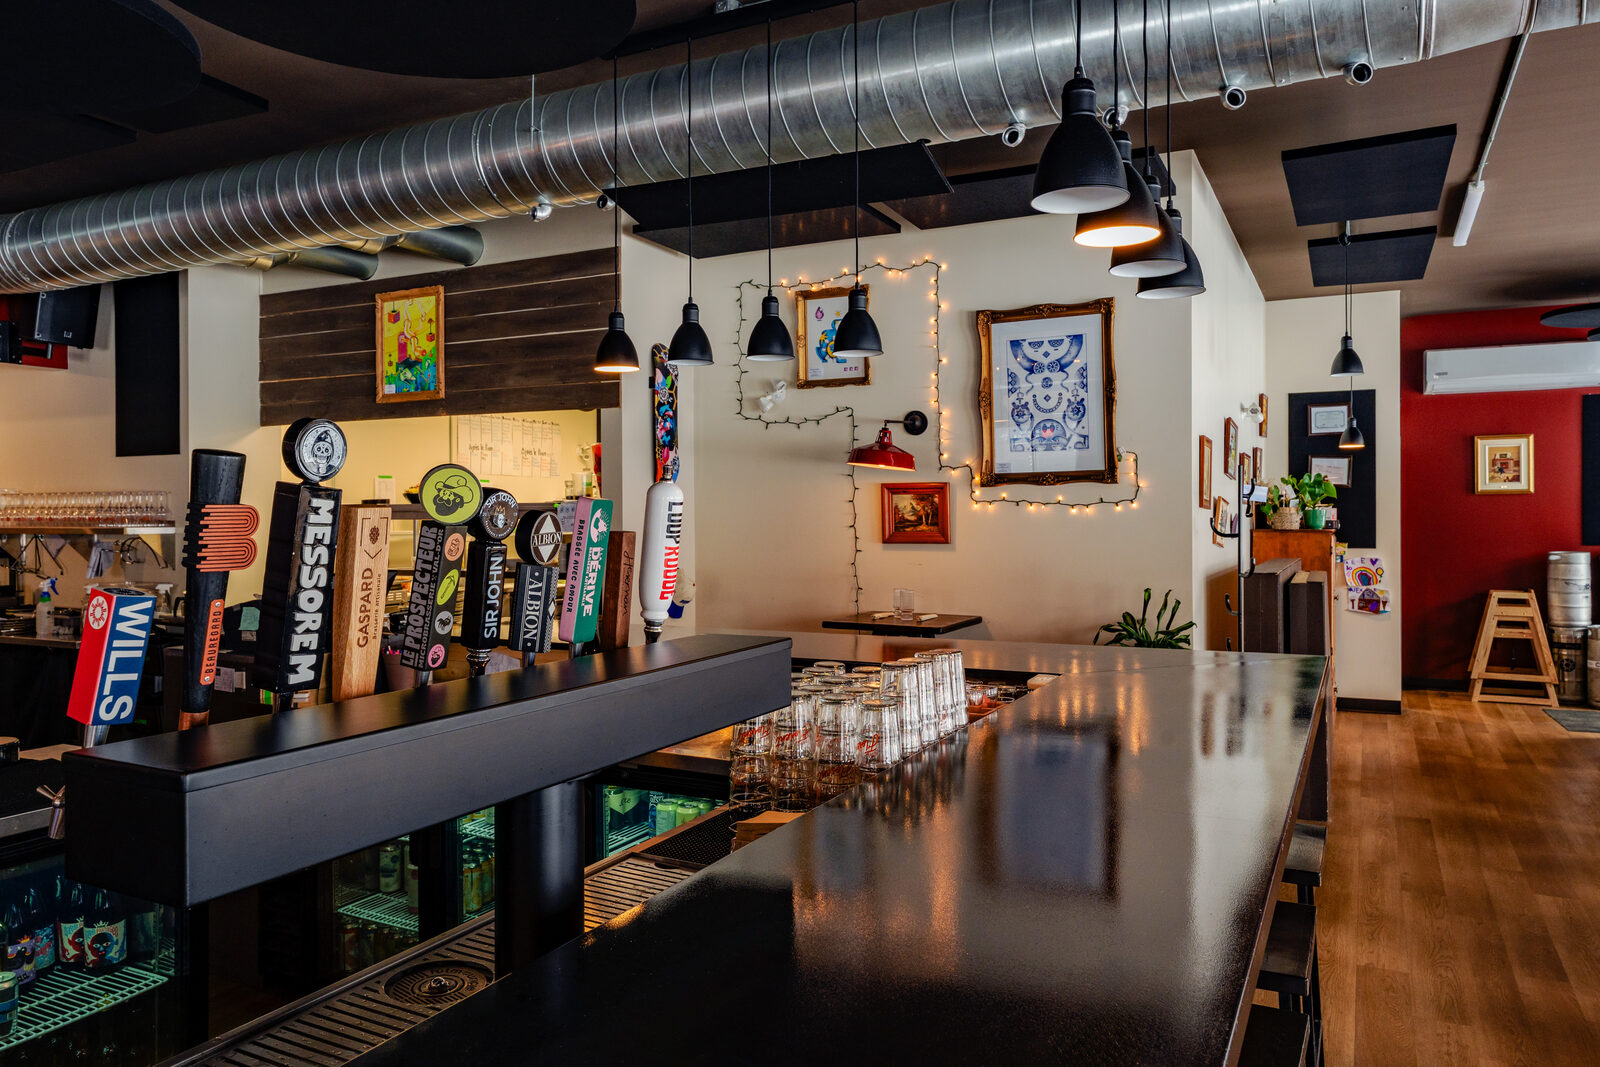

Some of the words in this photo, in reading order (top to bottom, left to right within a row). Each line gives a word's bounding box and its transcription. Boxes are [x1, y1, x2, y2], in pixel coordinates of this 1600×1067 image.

[485, 495, 497, 509] SIR
[498, 493, 516, 508] JOHN
[532, 532, 562, 547] ALBION
[575, 519, 586, 557] BRASSÉE
[286, 497, 335, 686] MESSOREM
[374, 572, 382, 605] artisanale
[405, 525, 439, 652] PROSPECTEUR
[486, 556, 503, 608] JOHN
[570, 560, 580, 581] AVEC
[582, 547, 602, 617] DÉRIVE
[356, 567, 375, 649] GASPARD
[418, 581, 436, 669] MICROBRASSERIE
[432, 528, 444, 574] VAL-D'OR
[523, 578, 543, 641] ALBION
[566, 583, 576, 613] AMOUR
[204, 609, 223, 676] BEAUREGARD
[371, 606, 380, 640] Brasserie
[484, 609, 498, 639] SIR
[98, 598, 154, 722] WILLS
[401, 648, 414, 666] LE
